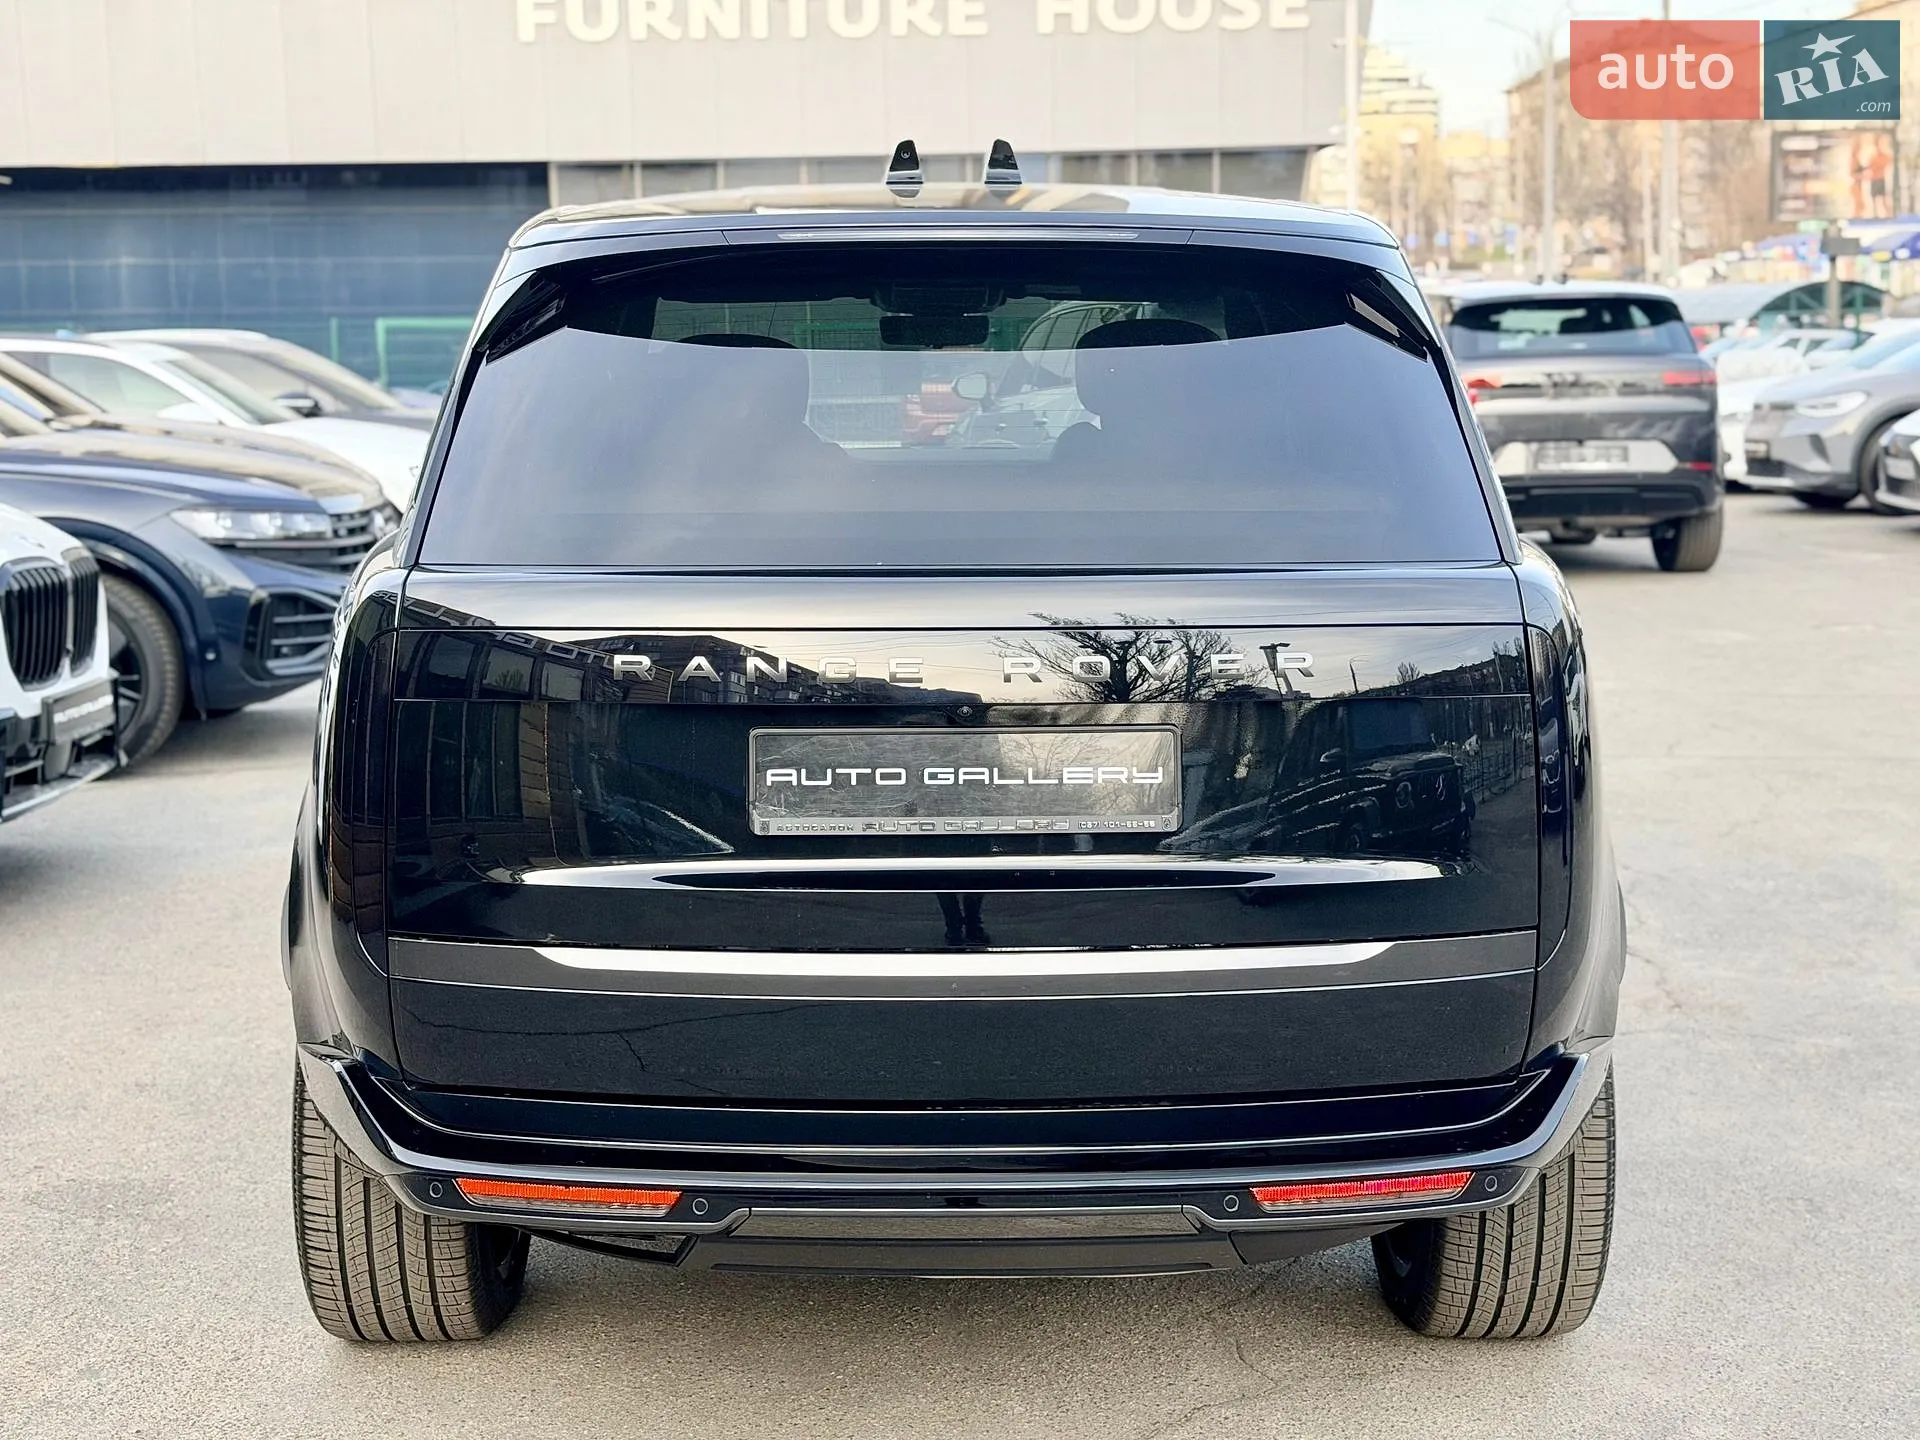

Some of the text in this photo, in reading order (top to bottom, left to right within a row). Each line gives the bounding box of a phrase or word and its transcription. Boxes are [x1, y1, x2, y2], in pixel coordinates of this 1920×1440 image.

[517, 0, 1311, 43] FURNITURE HOUSE
[612, 652, 1316, 683] RANGE ROVER
[766, 766, 1164, 787] AUTO GALLERY
